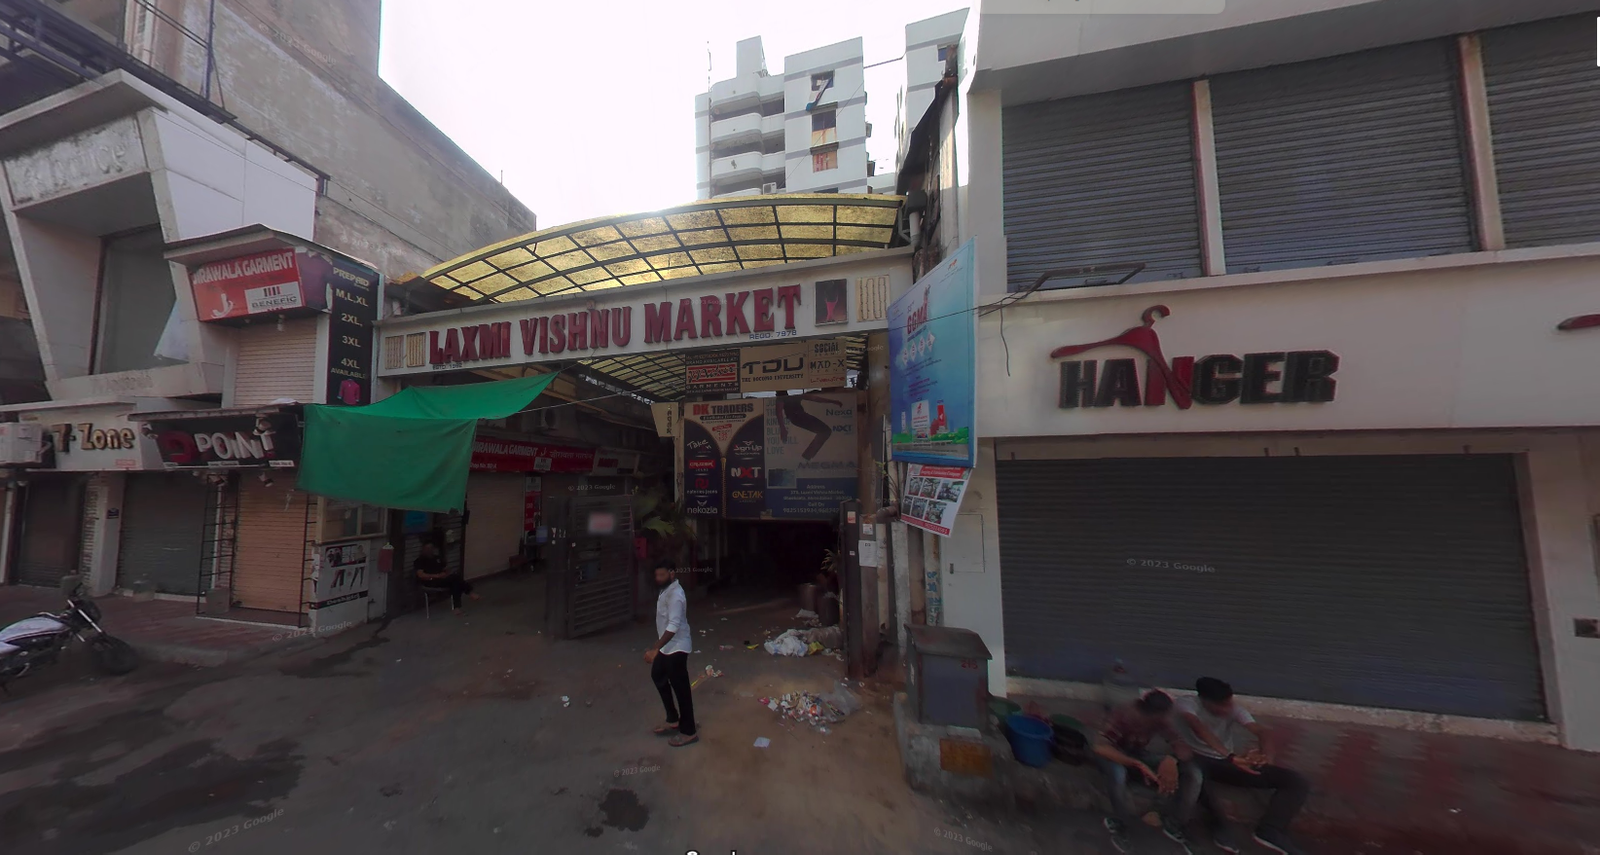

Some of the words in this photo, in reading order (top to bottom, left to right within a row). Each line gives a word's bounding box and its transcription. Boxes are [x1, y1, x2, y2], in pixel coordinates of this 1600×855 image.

[242, 252, 294, 275] GARMENT
[429, 321, 511, 364] LAXMI
[520, 306, 632, 356] VISHNU
[644, 284, 802, 344] MARKET
[776, 329, 797, 337] 7978
[342, 336, 361, 347] 3XL
[340, 358, 360, 369] 4XL
[742, 357, 804, 374] TDU
[331, 368, 366, 379] AVAILABLE
[1058, 350, 1339, 409] HANGER
[693, 403, 709, 415] DK
[711, 403, 754, 414] TRADERS
[825, 408, 853, 416] Nexa
[687, 439, 709, 450] Take
[508, 444, 538, 457] GARMENT
[767, 446, 784, 455] LOVE
[731, 467, 762, 478] NXT
